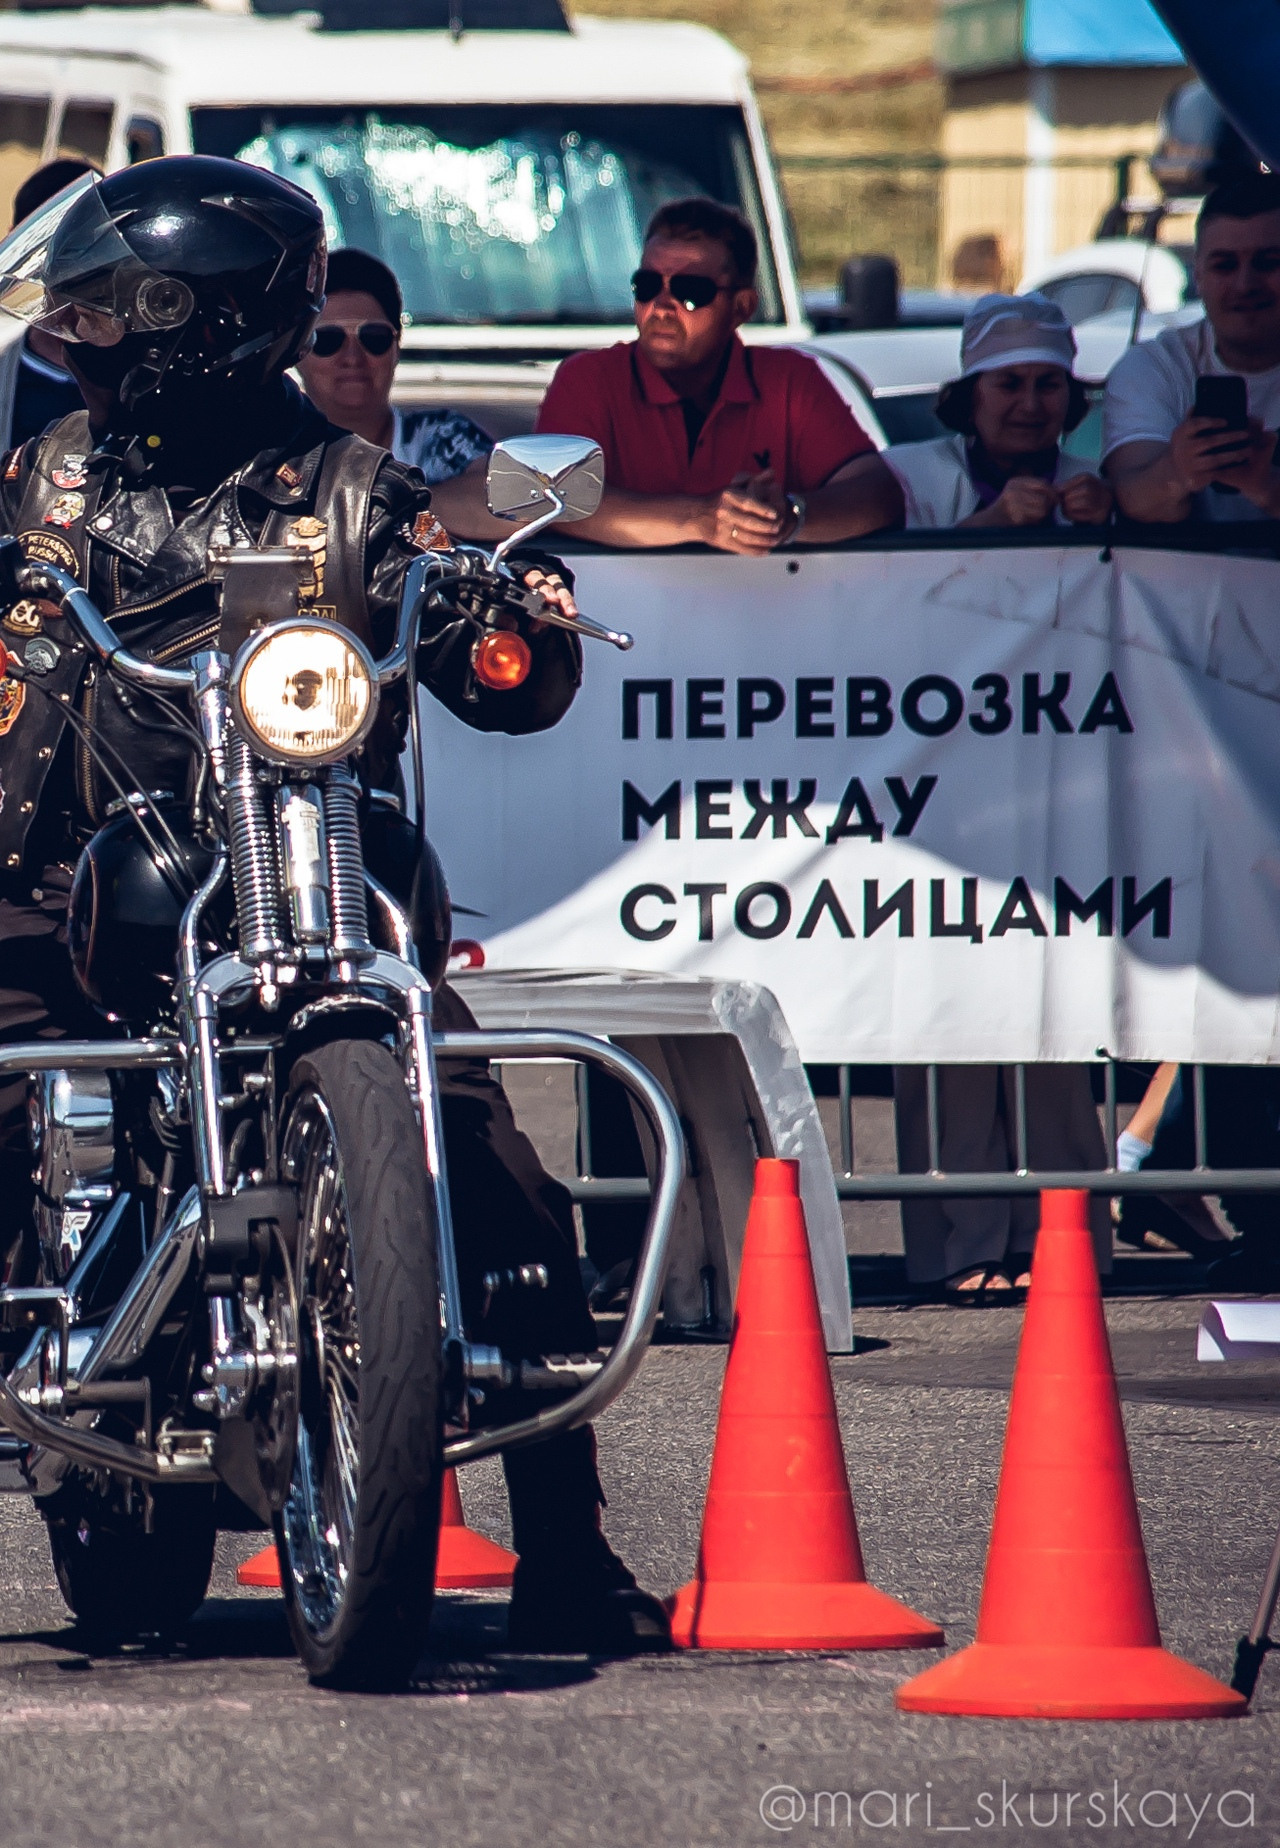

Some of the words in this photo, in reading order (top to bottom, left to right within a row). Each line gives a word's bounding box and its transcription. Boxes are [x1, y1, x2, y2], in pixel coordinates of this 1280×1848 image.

[621, 671, 1135, 740] ПЕРЕВОЗКА
[621, 774, 940, 844] МЕЖДУ
[619, 876, 1173, 945] СТОЛИЦАМИ
